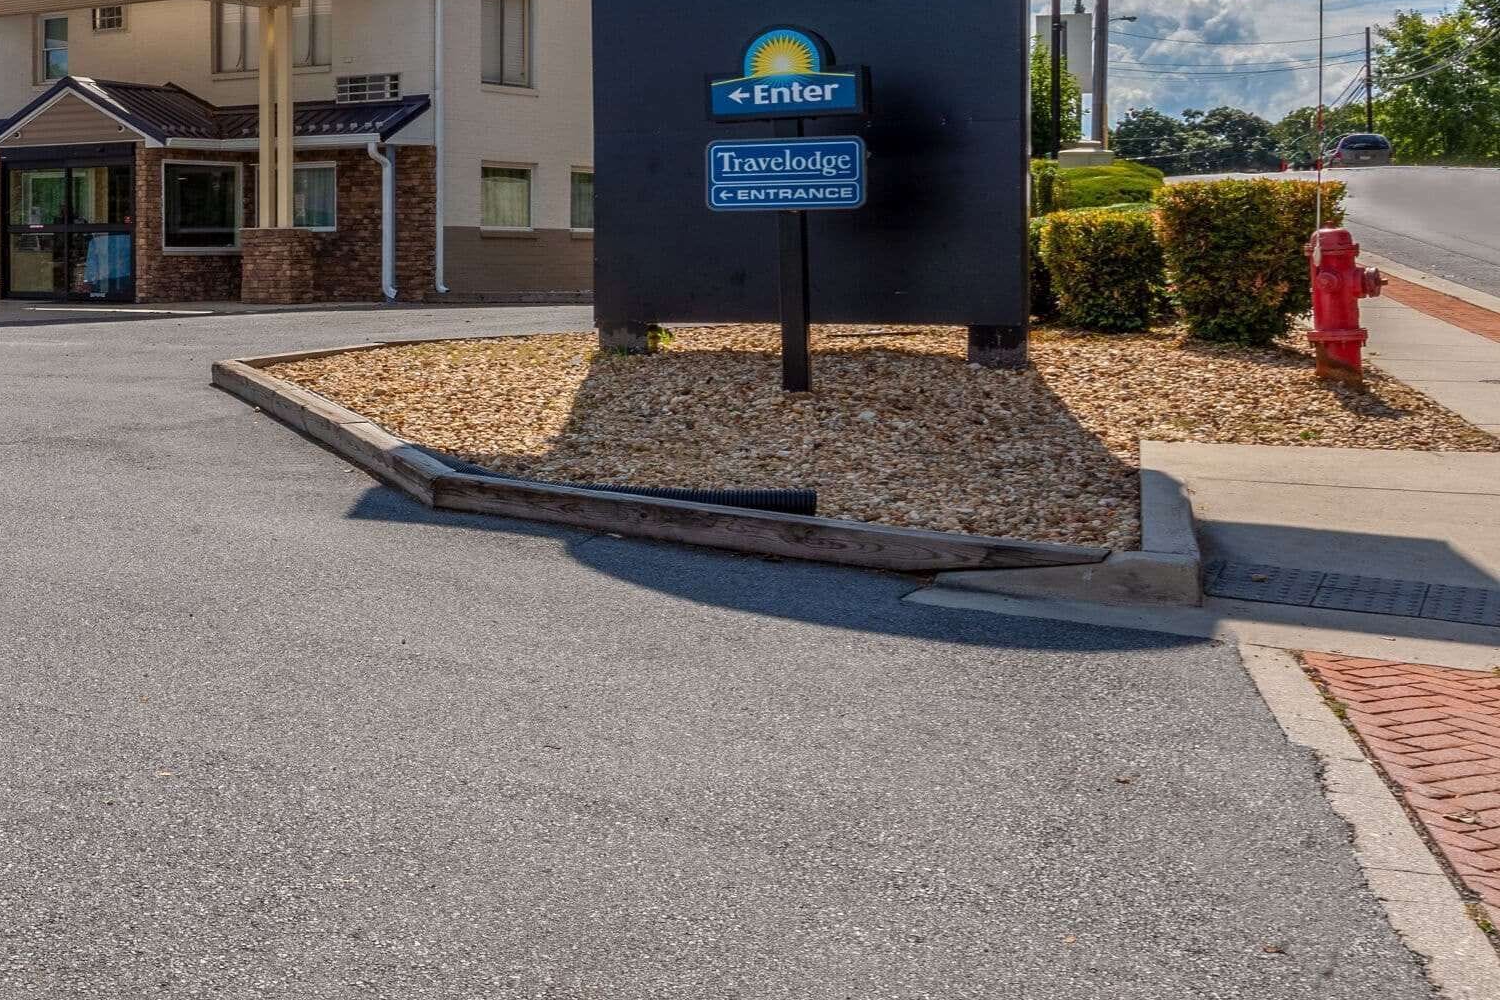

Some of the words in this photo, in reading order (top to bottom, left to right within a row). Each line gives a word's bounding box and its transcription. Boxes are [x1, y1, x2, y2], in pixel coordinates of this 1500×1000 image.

[753, 81, 840, 105] Enter
[716, 149, 852, 177] Travelodge
[736, 187, 853, 201] ENTRANCE
